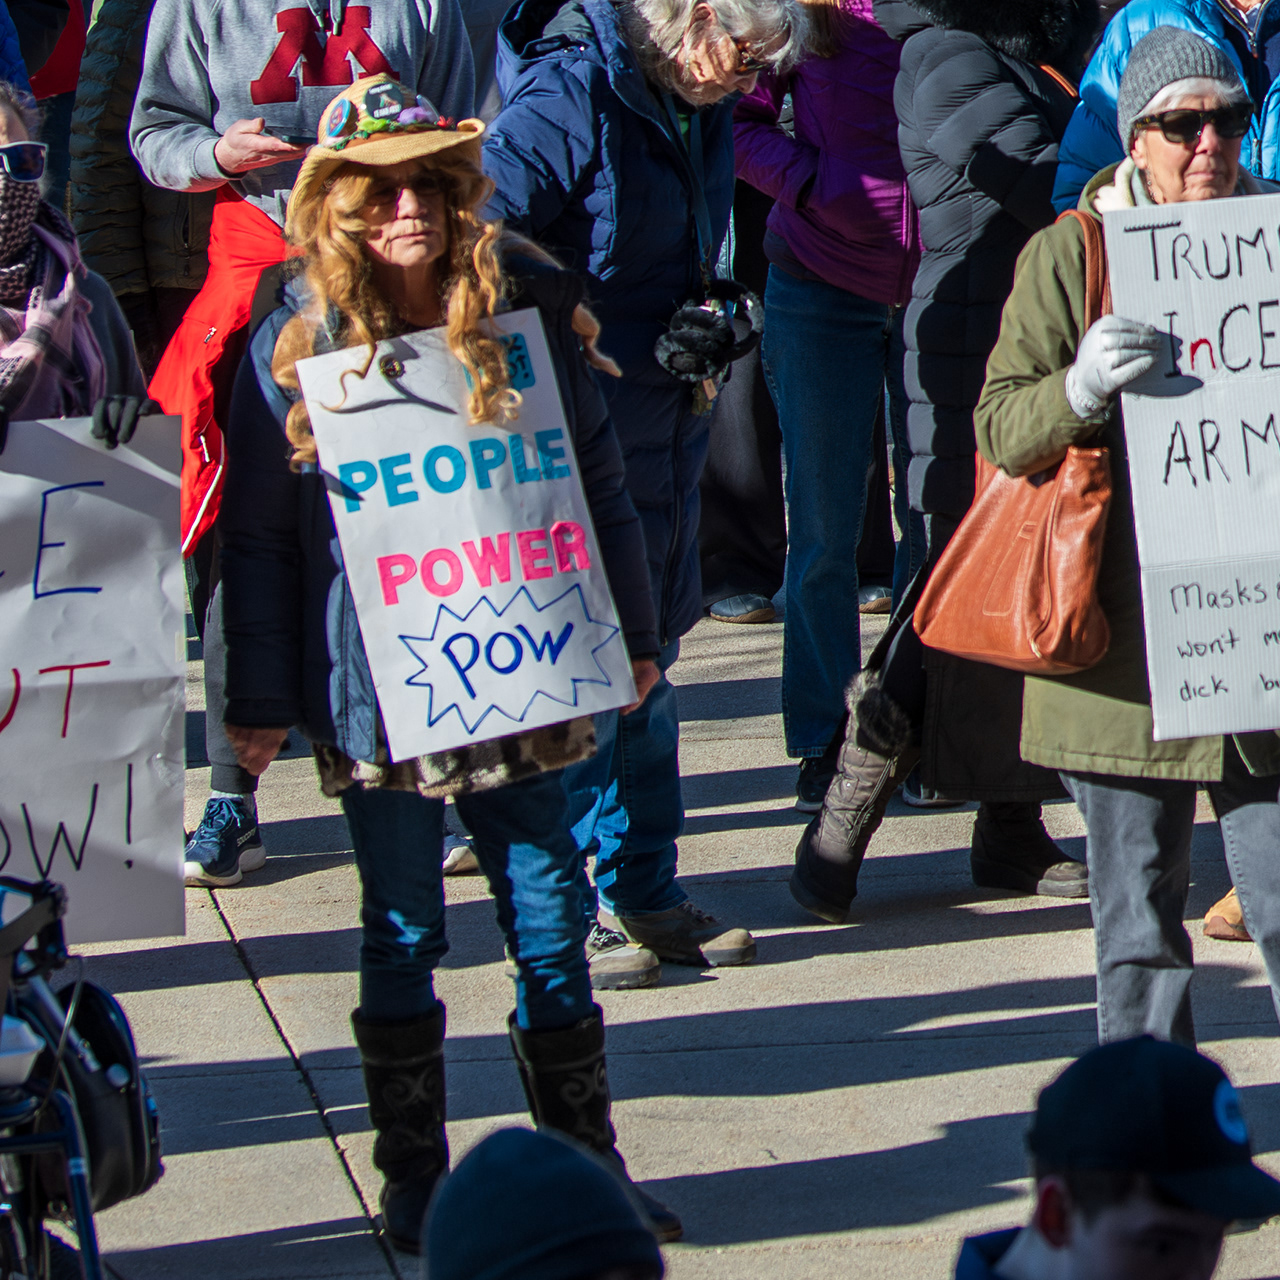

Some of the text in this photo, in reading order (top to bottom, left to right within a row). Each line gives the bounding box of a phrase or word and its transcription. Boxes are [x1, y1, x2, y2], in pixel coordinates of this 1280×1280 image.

[338, 428, 571, 513] PEOPLE
[376, 521, 591, 606] POWER
[1170, 574, 1271, 614] Masks
[442, 622, 573, 700] POW
[1179, 672, 1228, 701] dick
